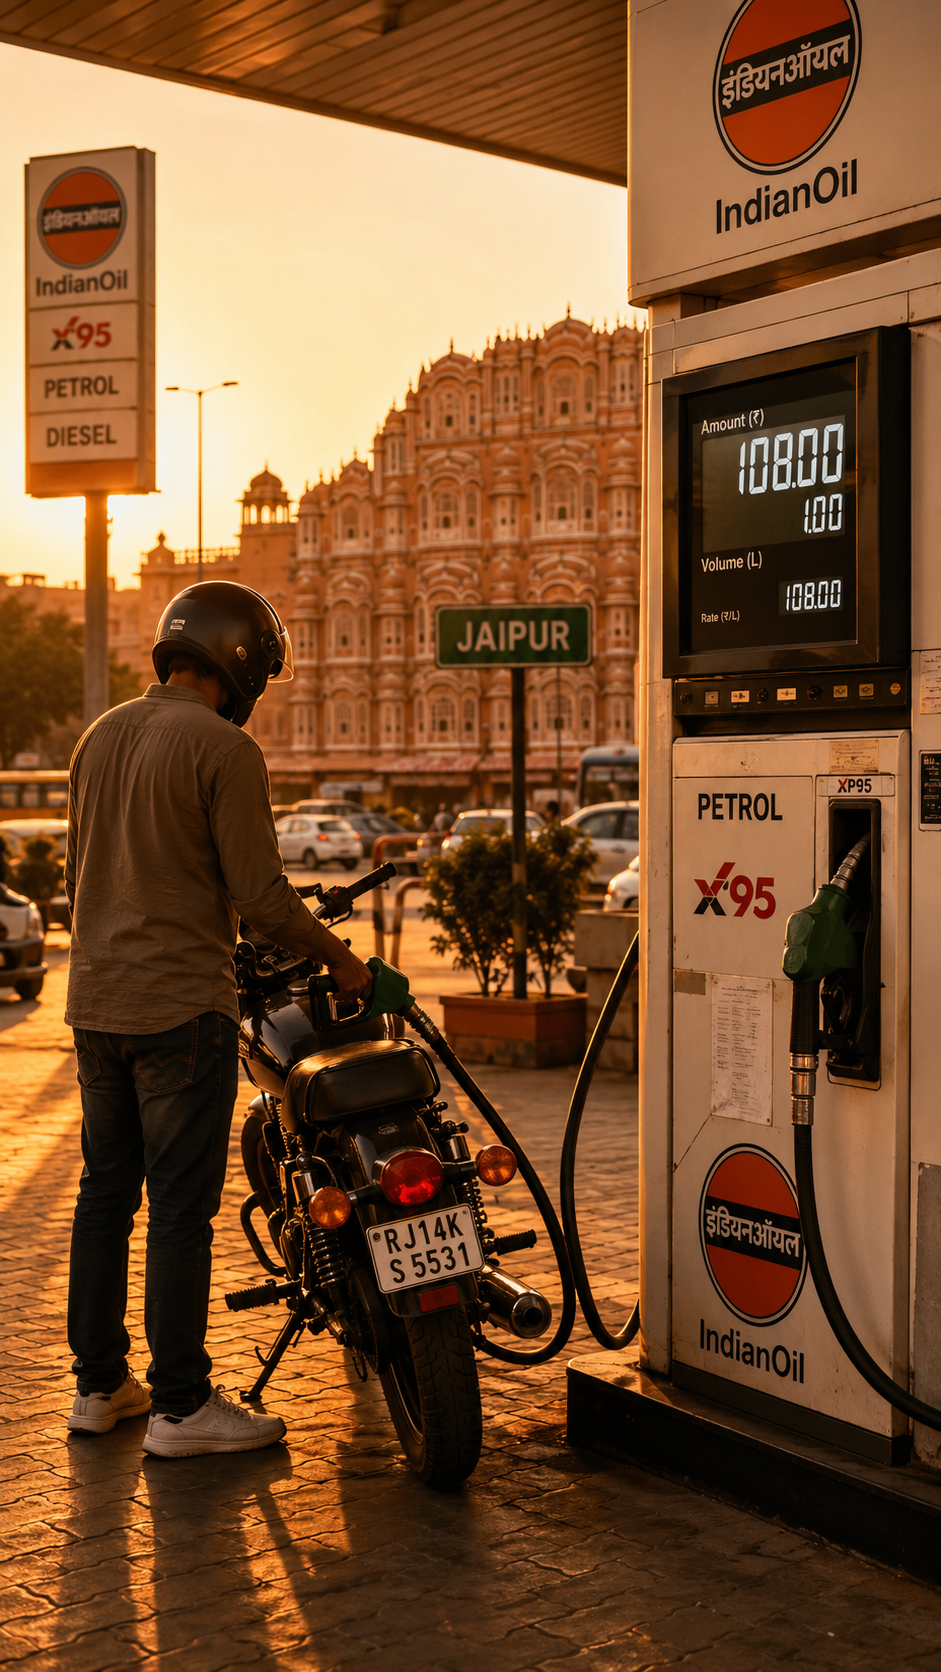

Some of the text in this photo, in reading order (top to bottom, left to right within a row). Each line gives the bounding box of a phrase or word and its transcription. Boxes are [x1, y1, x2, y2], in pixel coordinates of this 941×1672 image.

[721, 34, 851, 110] इंडियनऑयल
[716, 158, 858, 235] IndianOil
[36, 269, 128, 297] IndianOil
[44, 375, 119, 399] PETROL
[46, 424, 117, 448] DIESEL
[701, 408, 765, 435] Amount (₹)
[738, 422, 844, 495] 108.00
[803, 493, 843, 534] 1.00
[701, 550, 763, 573] Volume (L)
[785, 579, 842, 611] 108.00
[701, 613, 719, 623] Rate
[456, 620, 570, 653] JAIPUR
[837, 777, 872, 794] XP95
[697, 792, 783, 821] PETROL
[384, 1212, 464, 1254] RJ14K
[705, 1205, 801, 1258] इंडियनऑयल
[389, 1241, 470, 1284] S 5531
[700, 1318, 805, 1384] IndianOil
